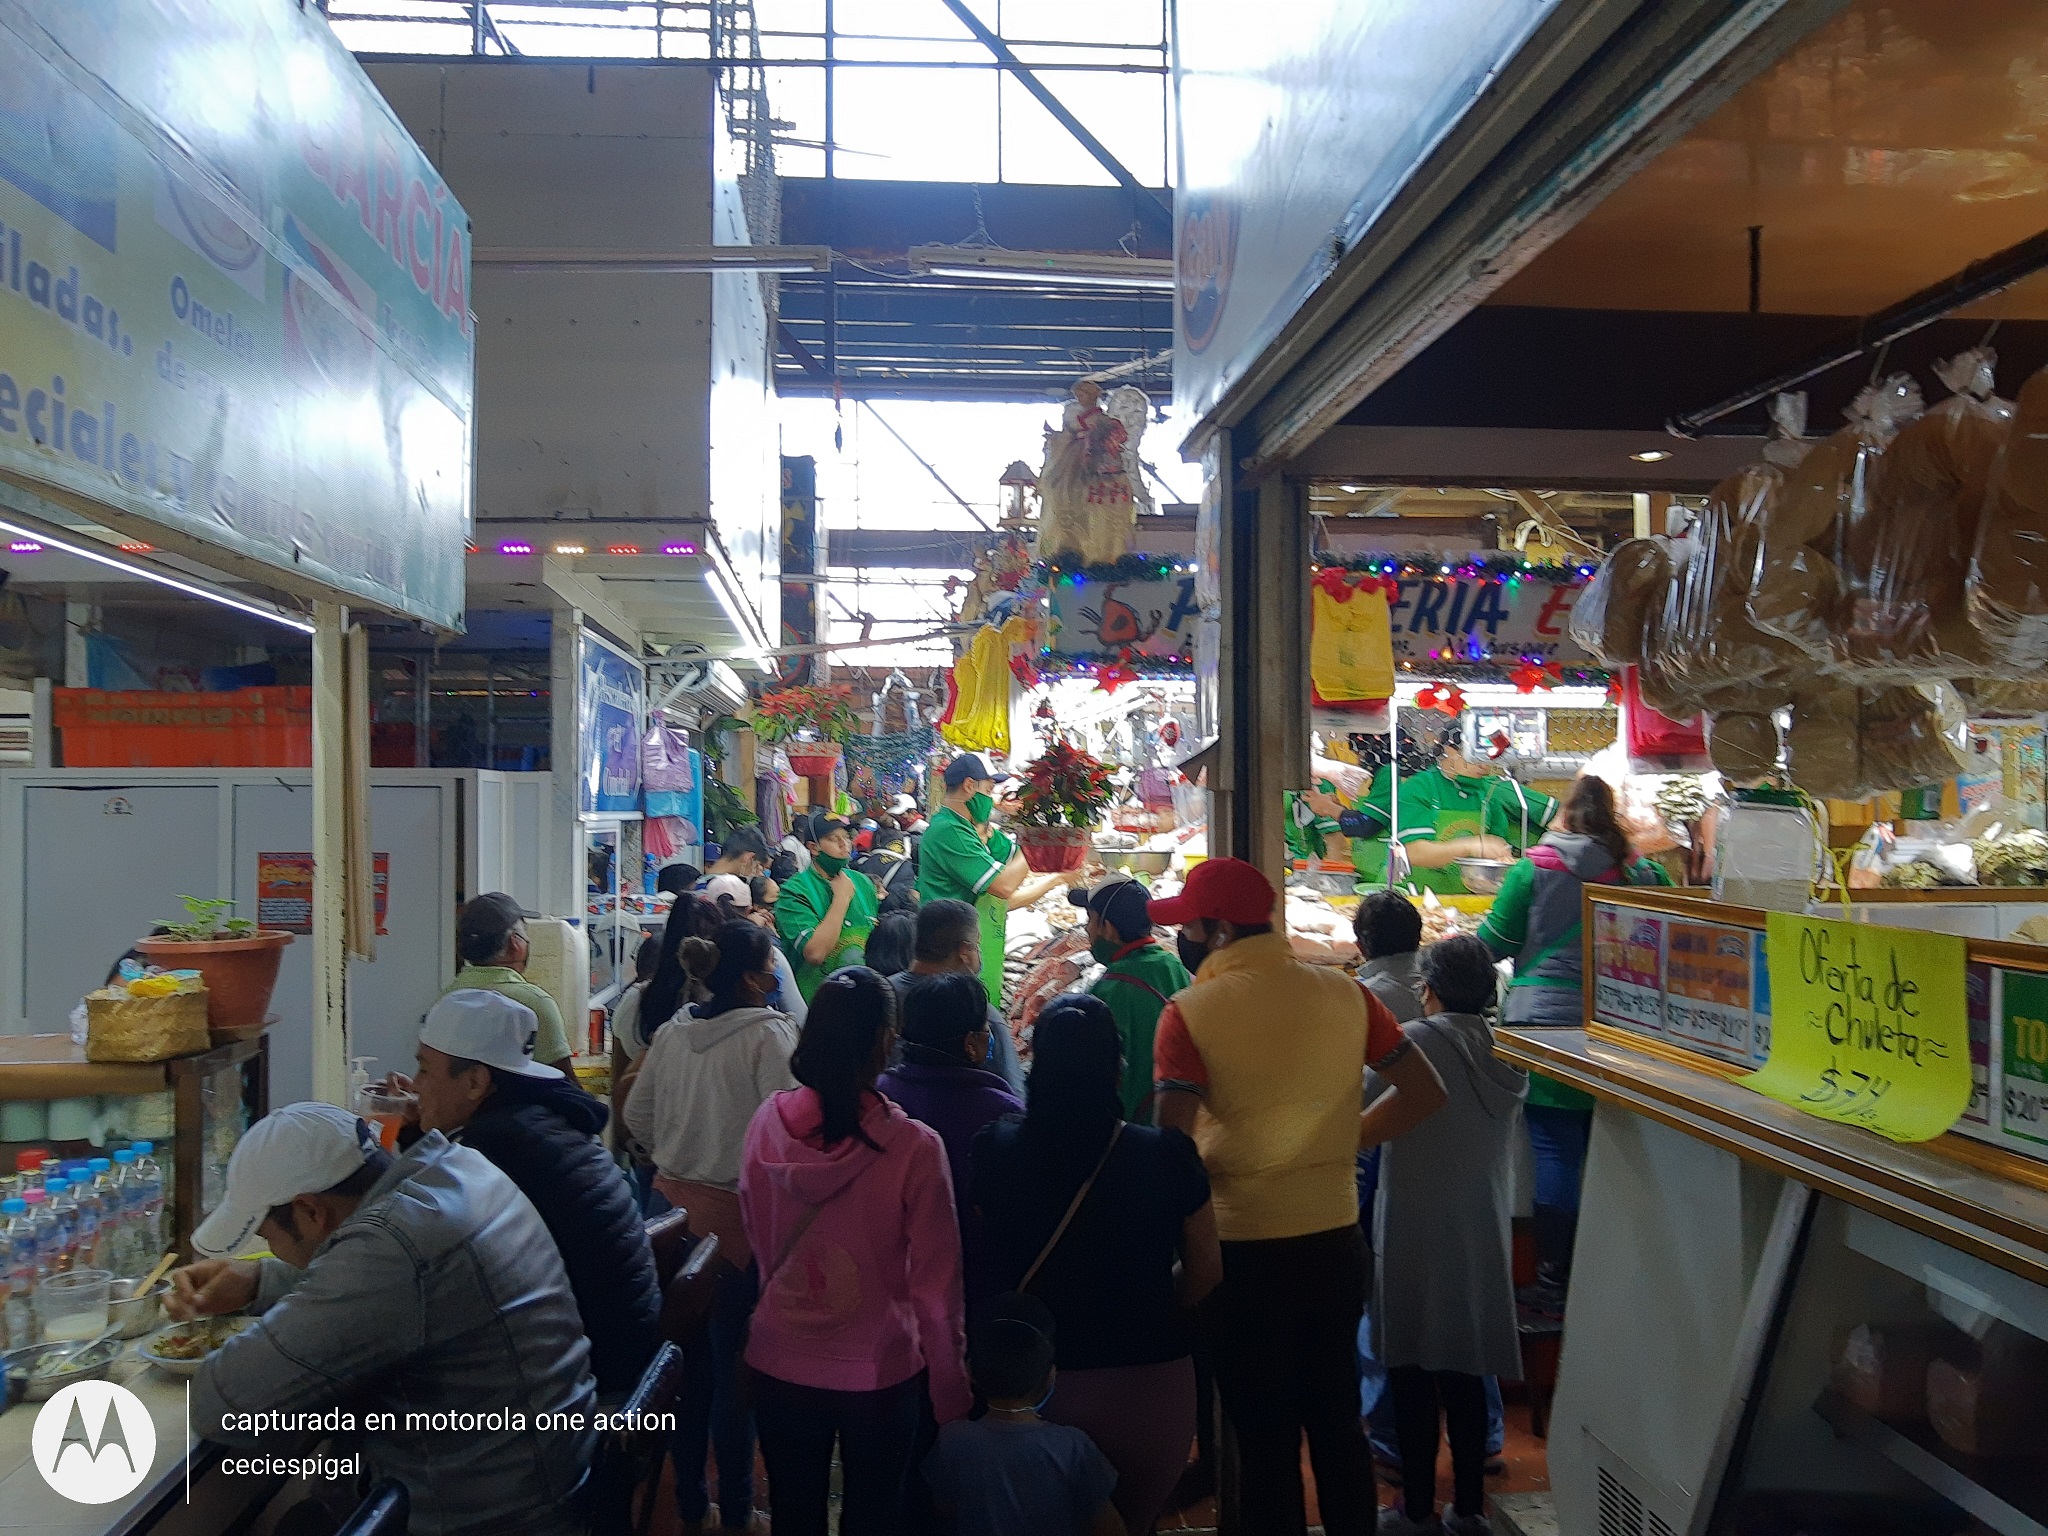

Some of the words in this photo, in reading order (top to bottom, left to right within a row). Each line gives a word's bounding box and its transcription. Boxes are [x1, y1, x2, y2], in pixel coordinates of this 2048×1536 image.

[1800, 926, 1877, 1005] Oferta
[1883, 946, 1921, 1018] de
[1825, 993, 1922, 1068] Chuleta
